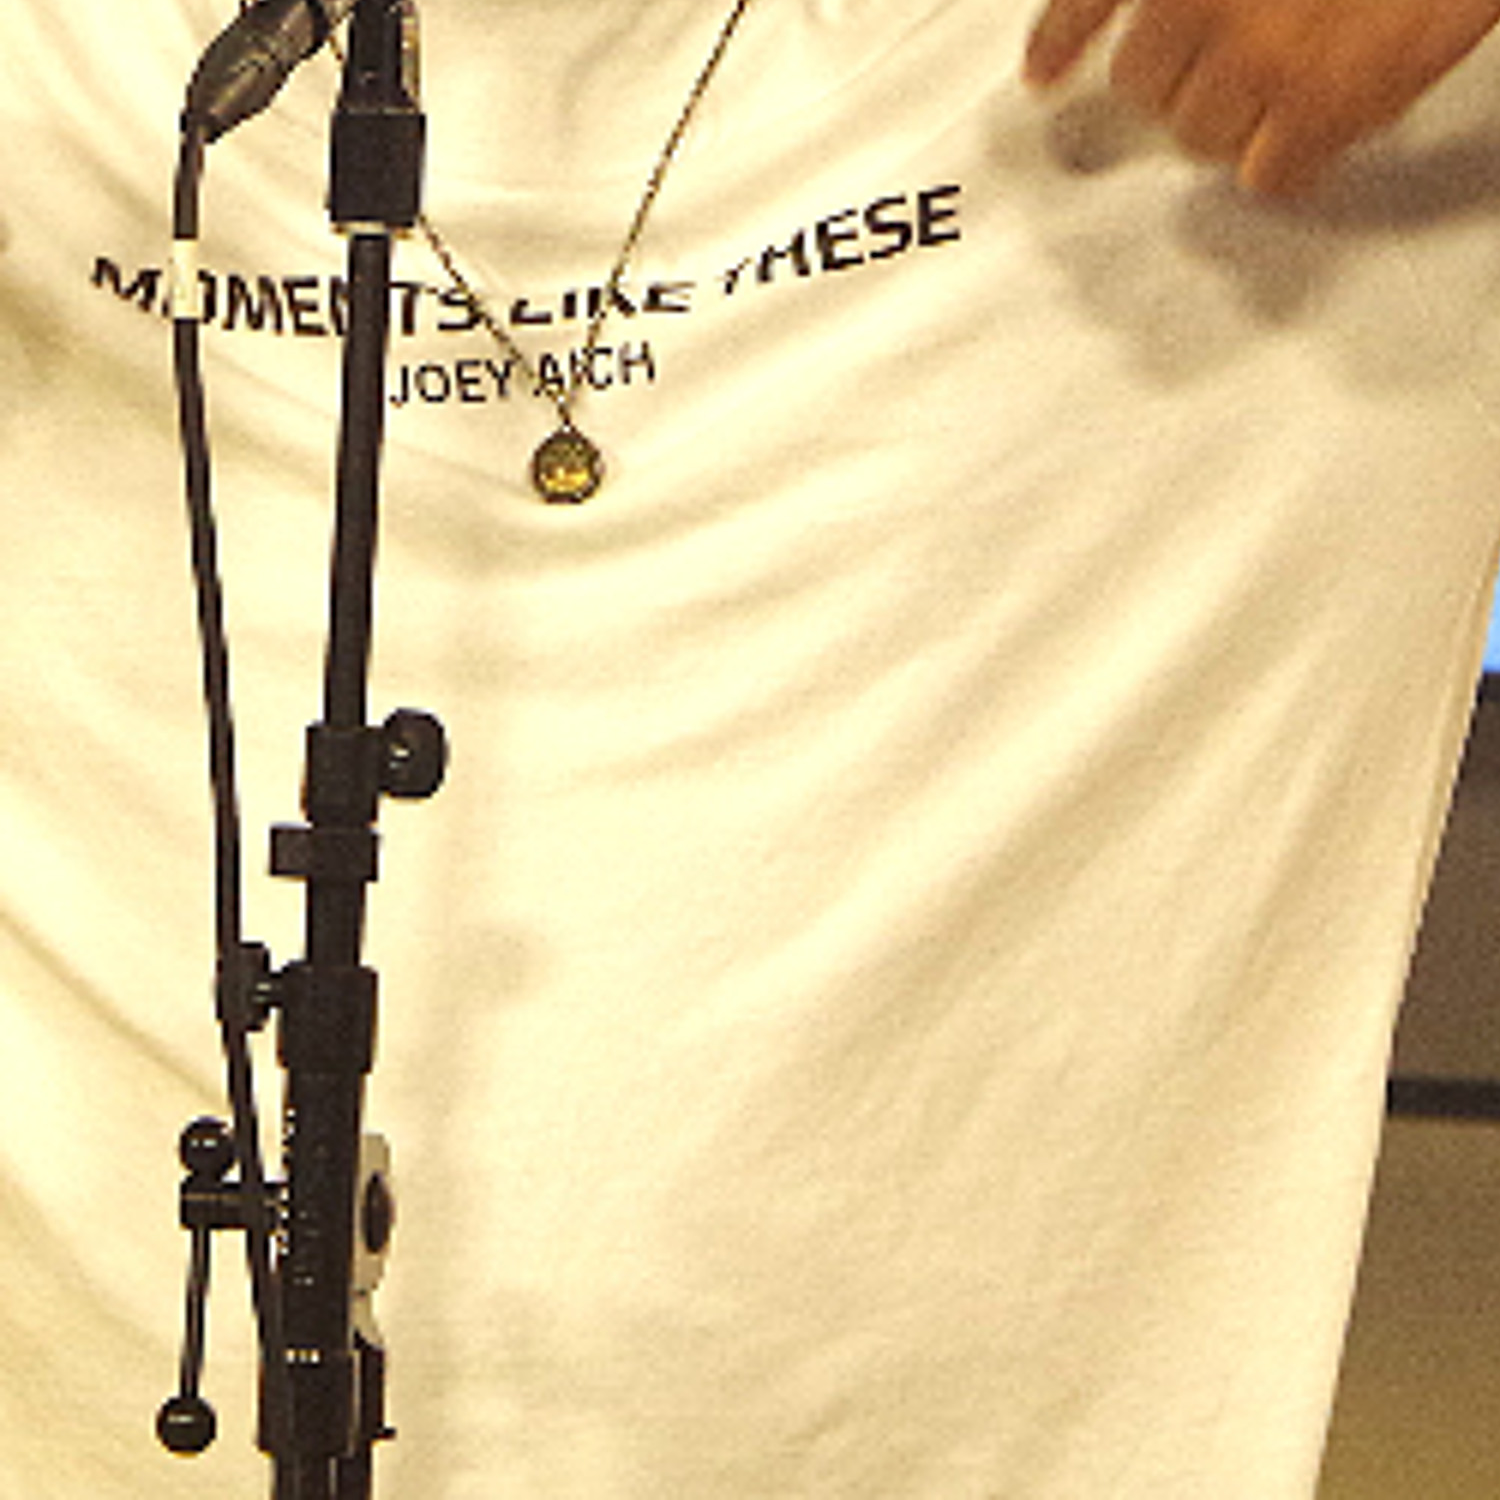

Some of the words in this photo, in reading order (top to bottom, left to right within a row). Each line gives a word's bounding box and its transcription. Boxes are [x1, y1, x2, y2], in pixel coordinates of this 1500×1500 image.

[510, 283, 694, 325] LIKE
[390, 359, 514, 407] JOEY
[534, 341, 656, 398] AICH
